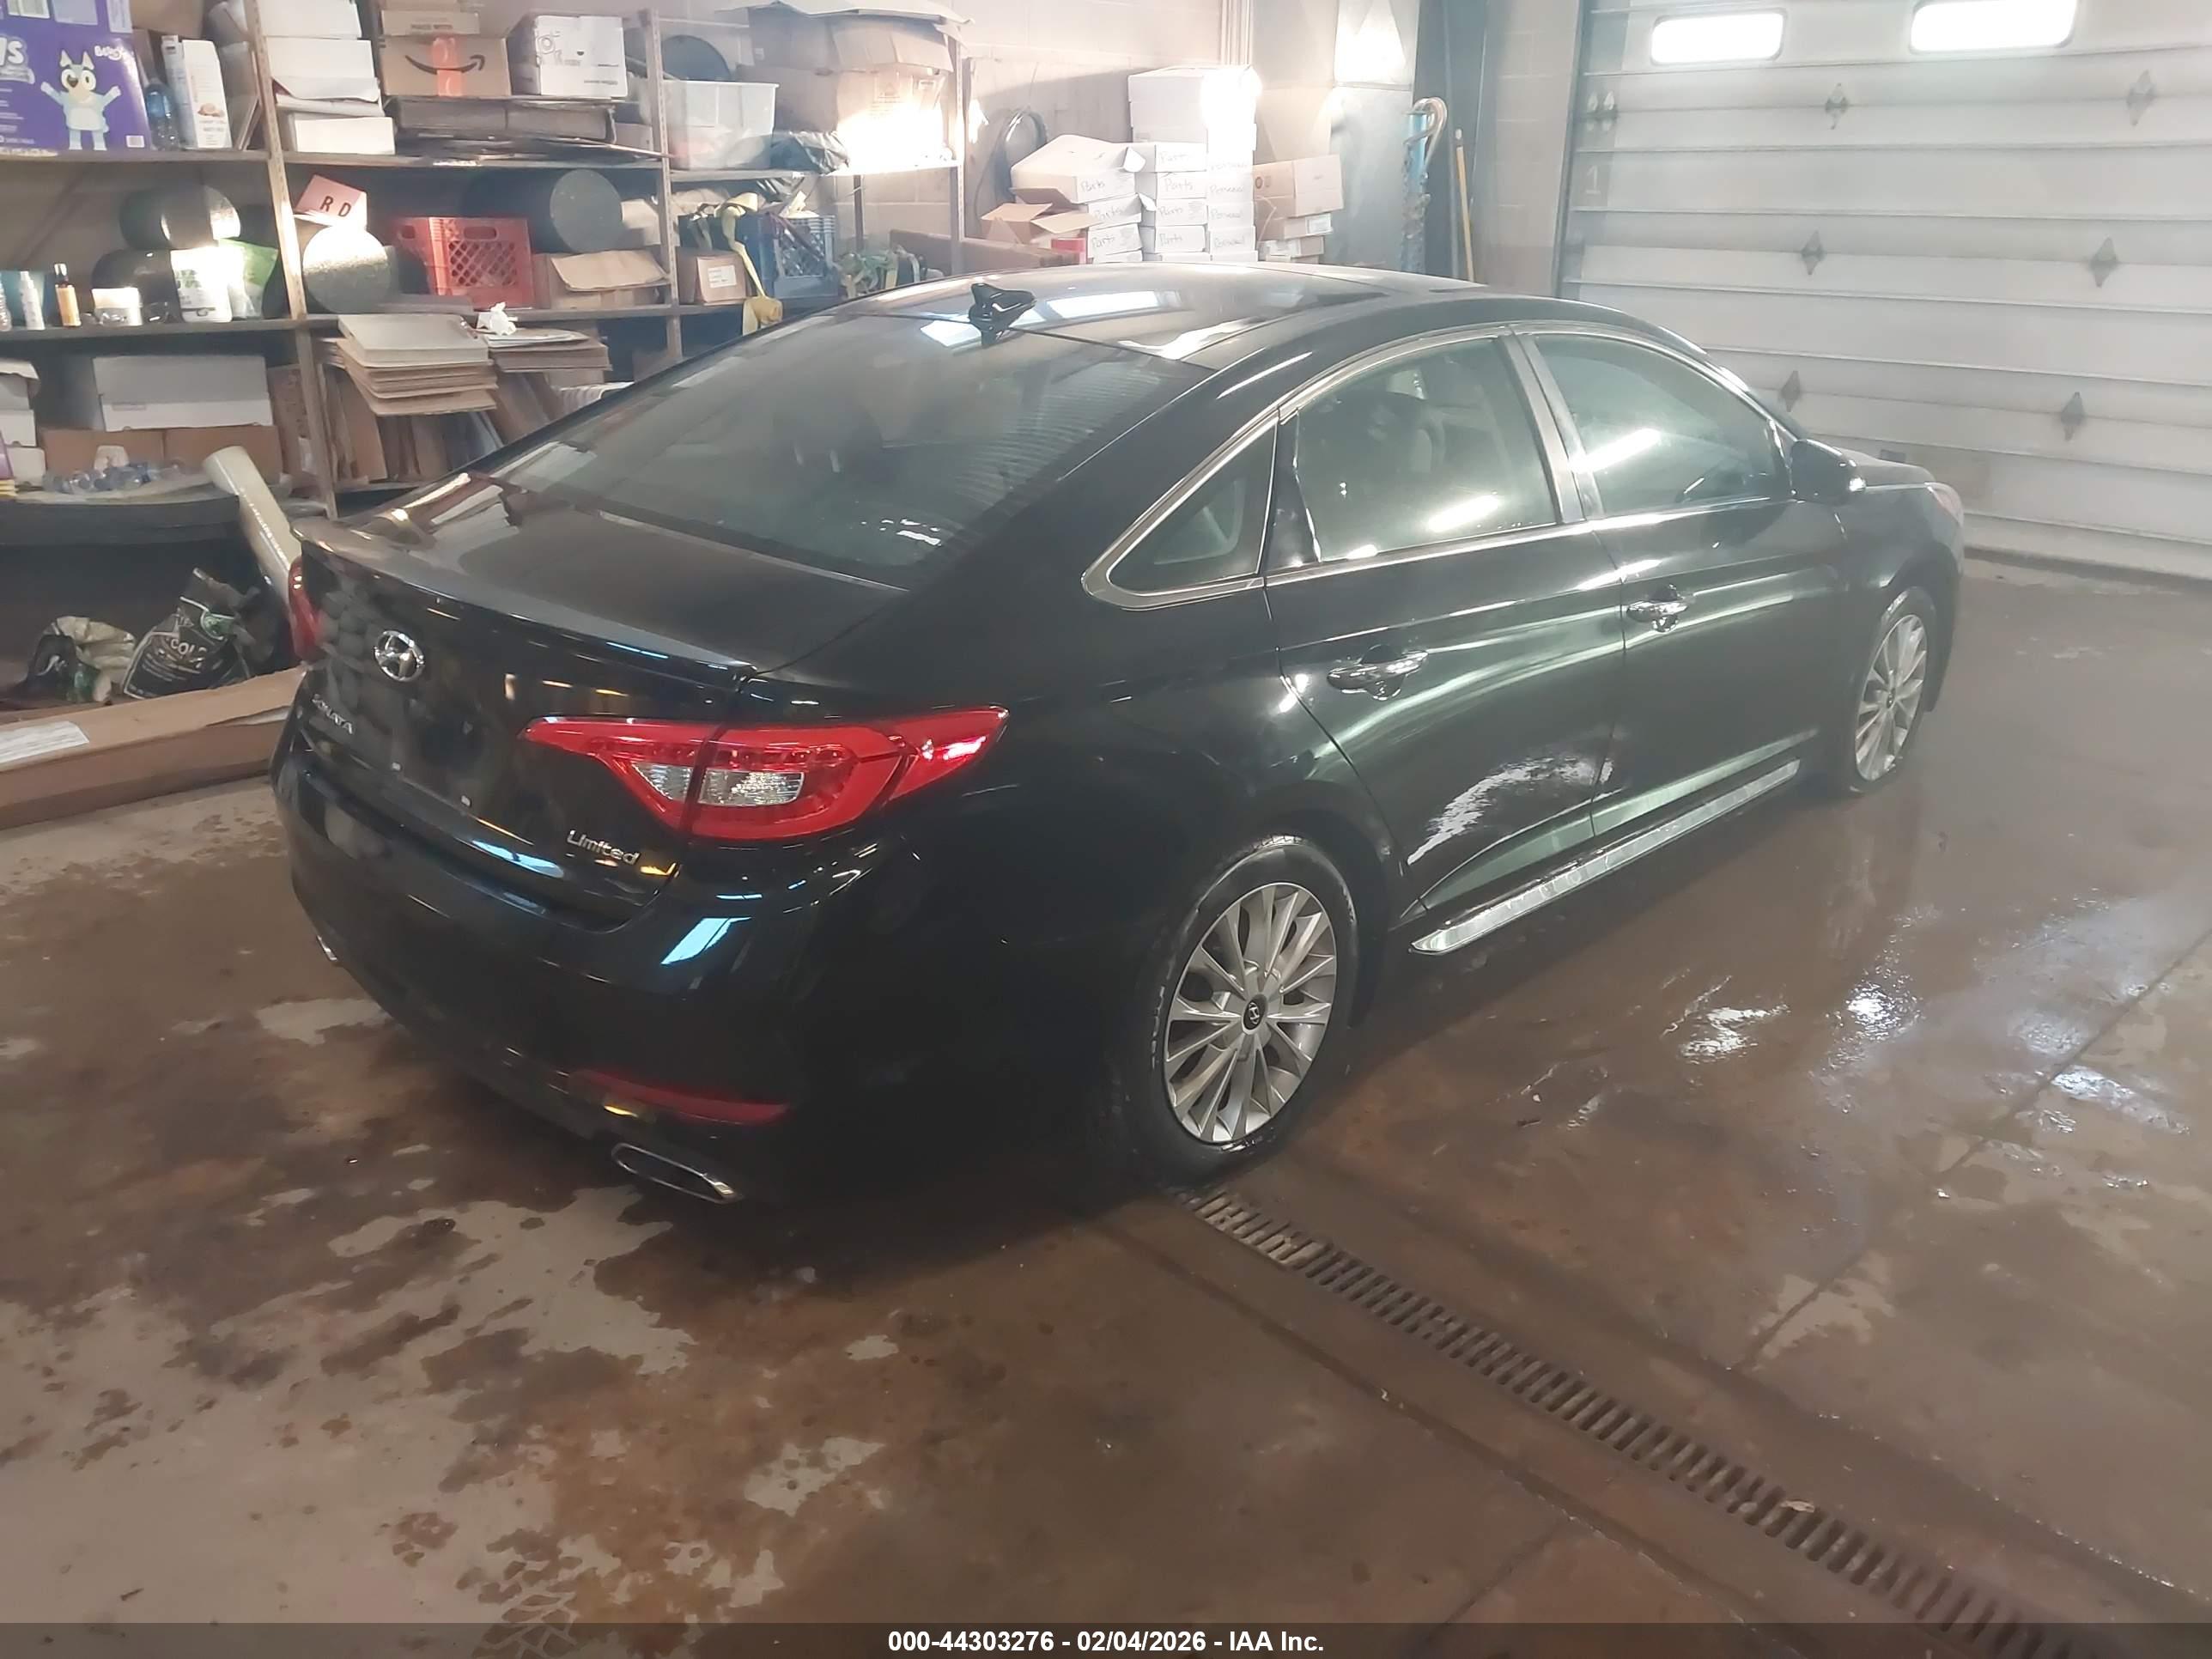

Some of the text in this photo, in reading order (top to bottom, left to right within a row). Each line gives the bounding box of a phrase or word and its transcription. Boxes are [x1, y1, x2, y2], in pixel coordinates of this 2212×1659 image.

[319, 195, 352, 217] R D
[567, 830, 641, 866] Limited
